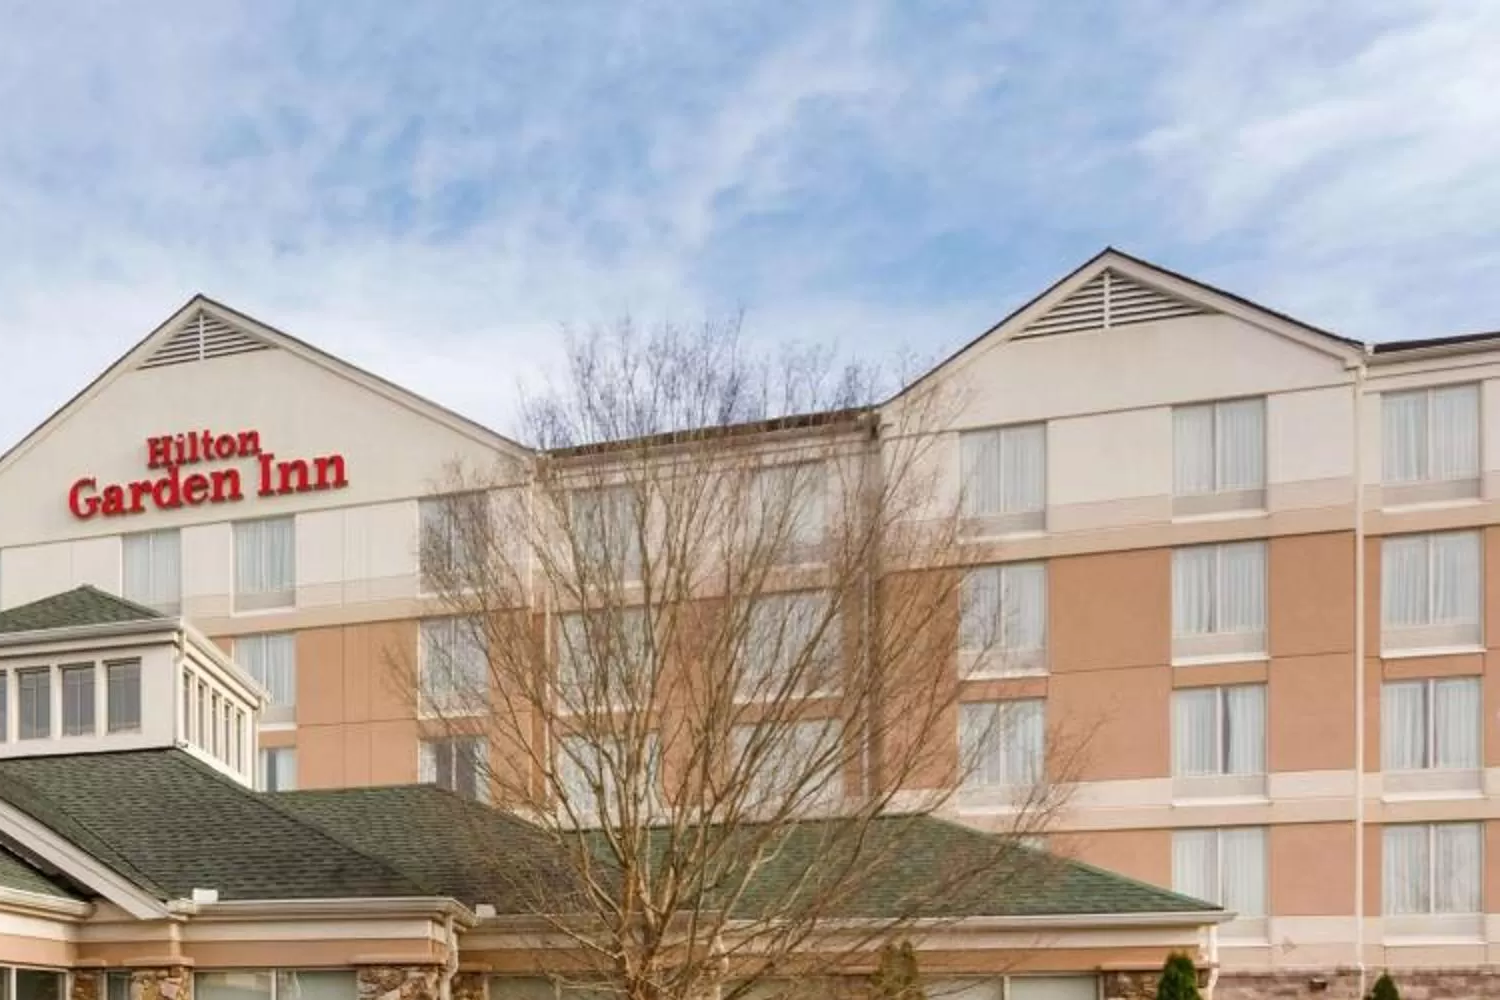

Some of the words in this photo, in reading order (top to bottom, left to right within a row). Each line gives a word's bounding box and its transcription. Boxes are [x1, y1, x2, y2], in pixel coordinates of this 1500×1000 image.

[146, 429, 262, 469] Hilton
[68, 464, 243, 519] Garden
[257, 453, 348, 497] Inn
